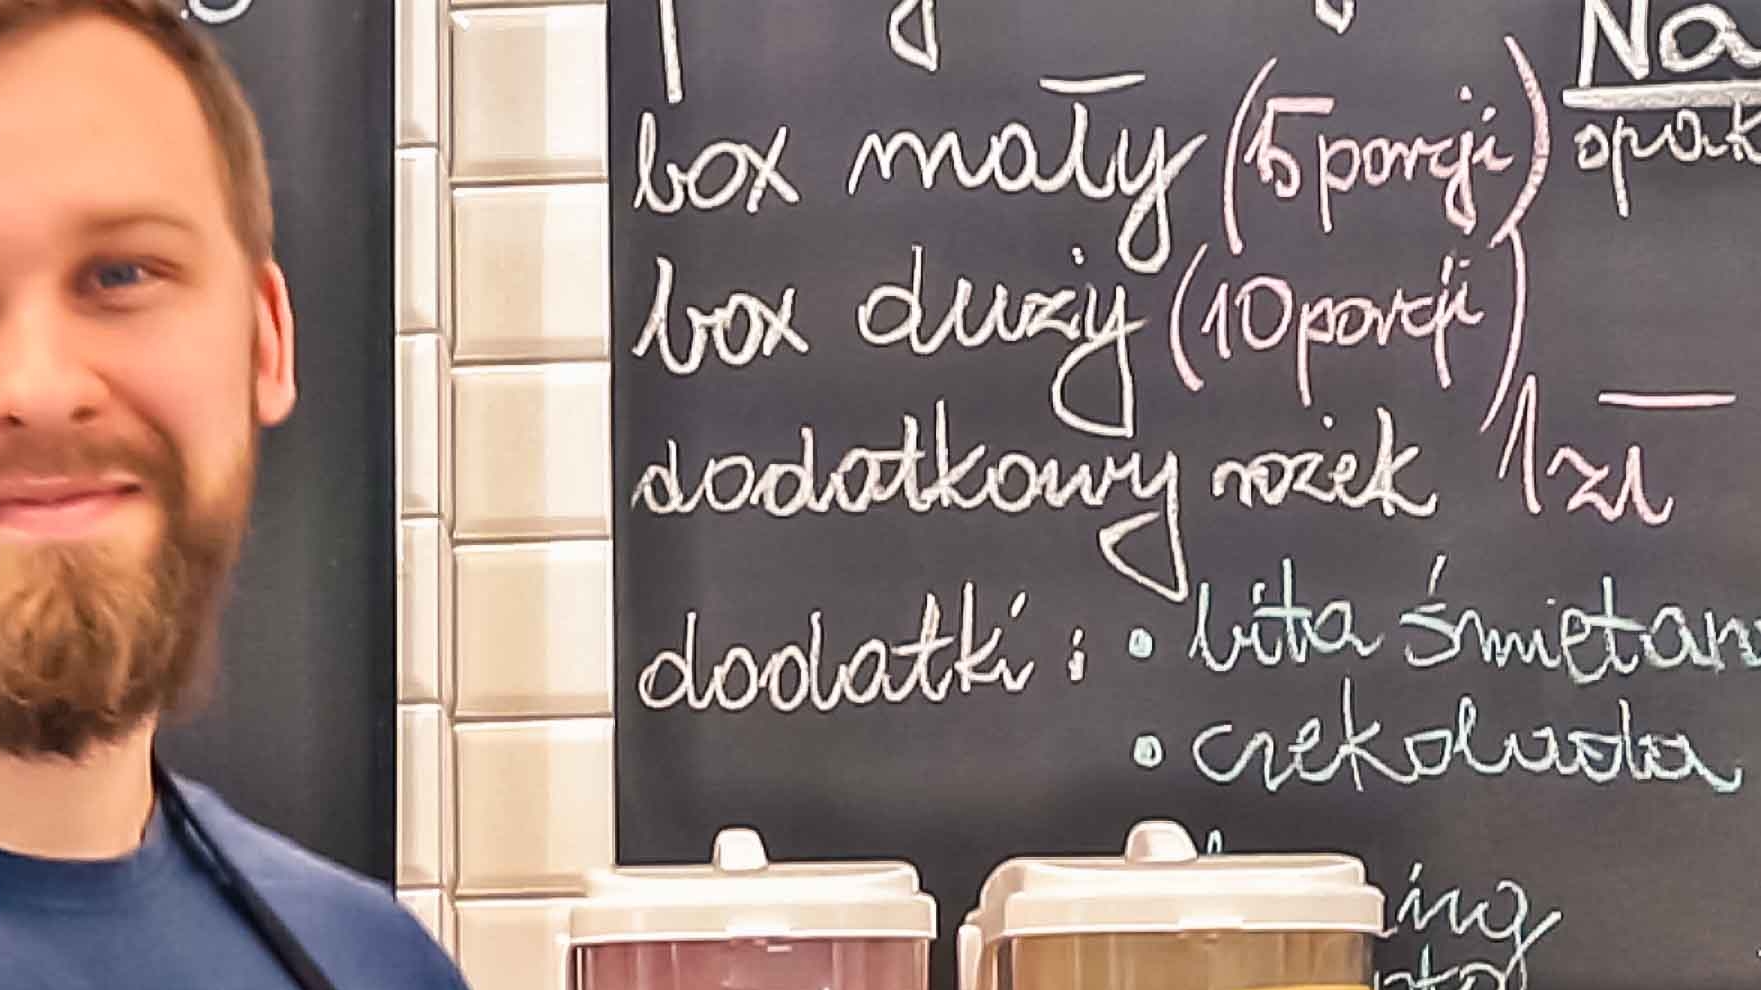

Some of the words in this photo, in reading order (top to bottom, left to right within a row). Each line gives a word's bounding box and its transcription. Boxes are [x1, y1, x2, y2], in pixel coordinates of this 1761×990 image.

[634, 111, 800, 213] box
[632, 256, 809, 376] box
[857, 245, 1149, 438] duży
[631, 399, 1189, 603] dodatkowy
[1188, 557, 1386, 672] bita
[1399, 554, 1761, 685] śmietan
